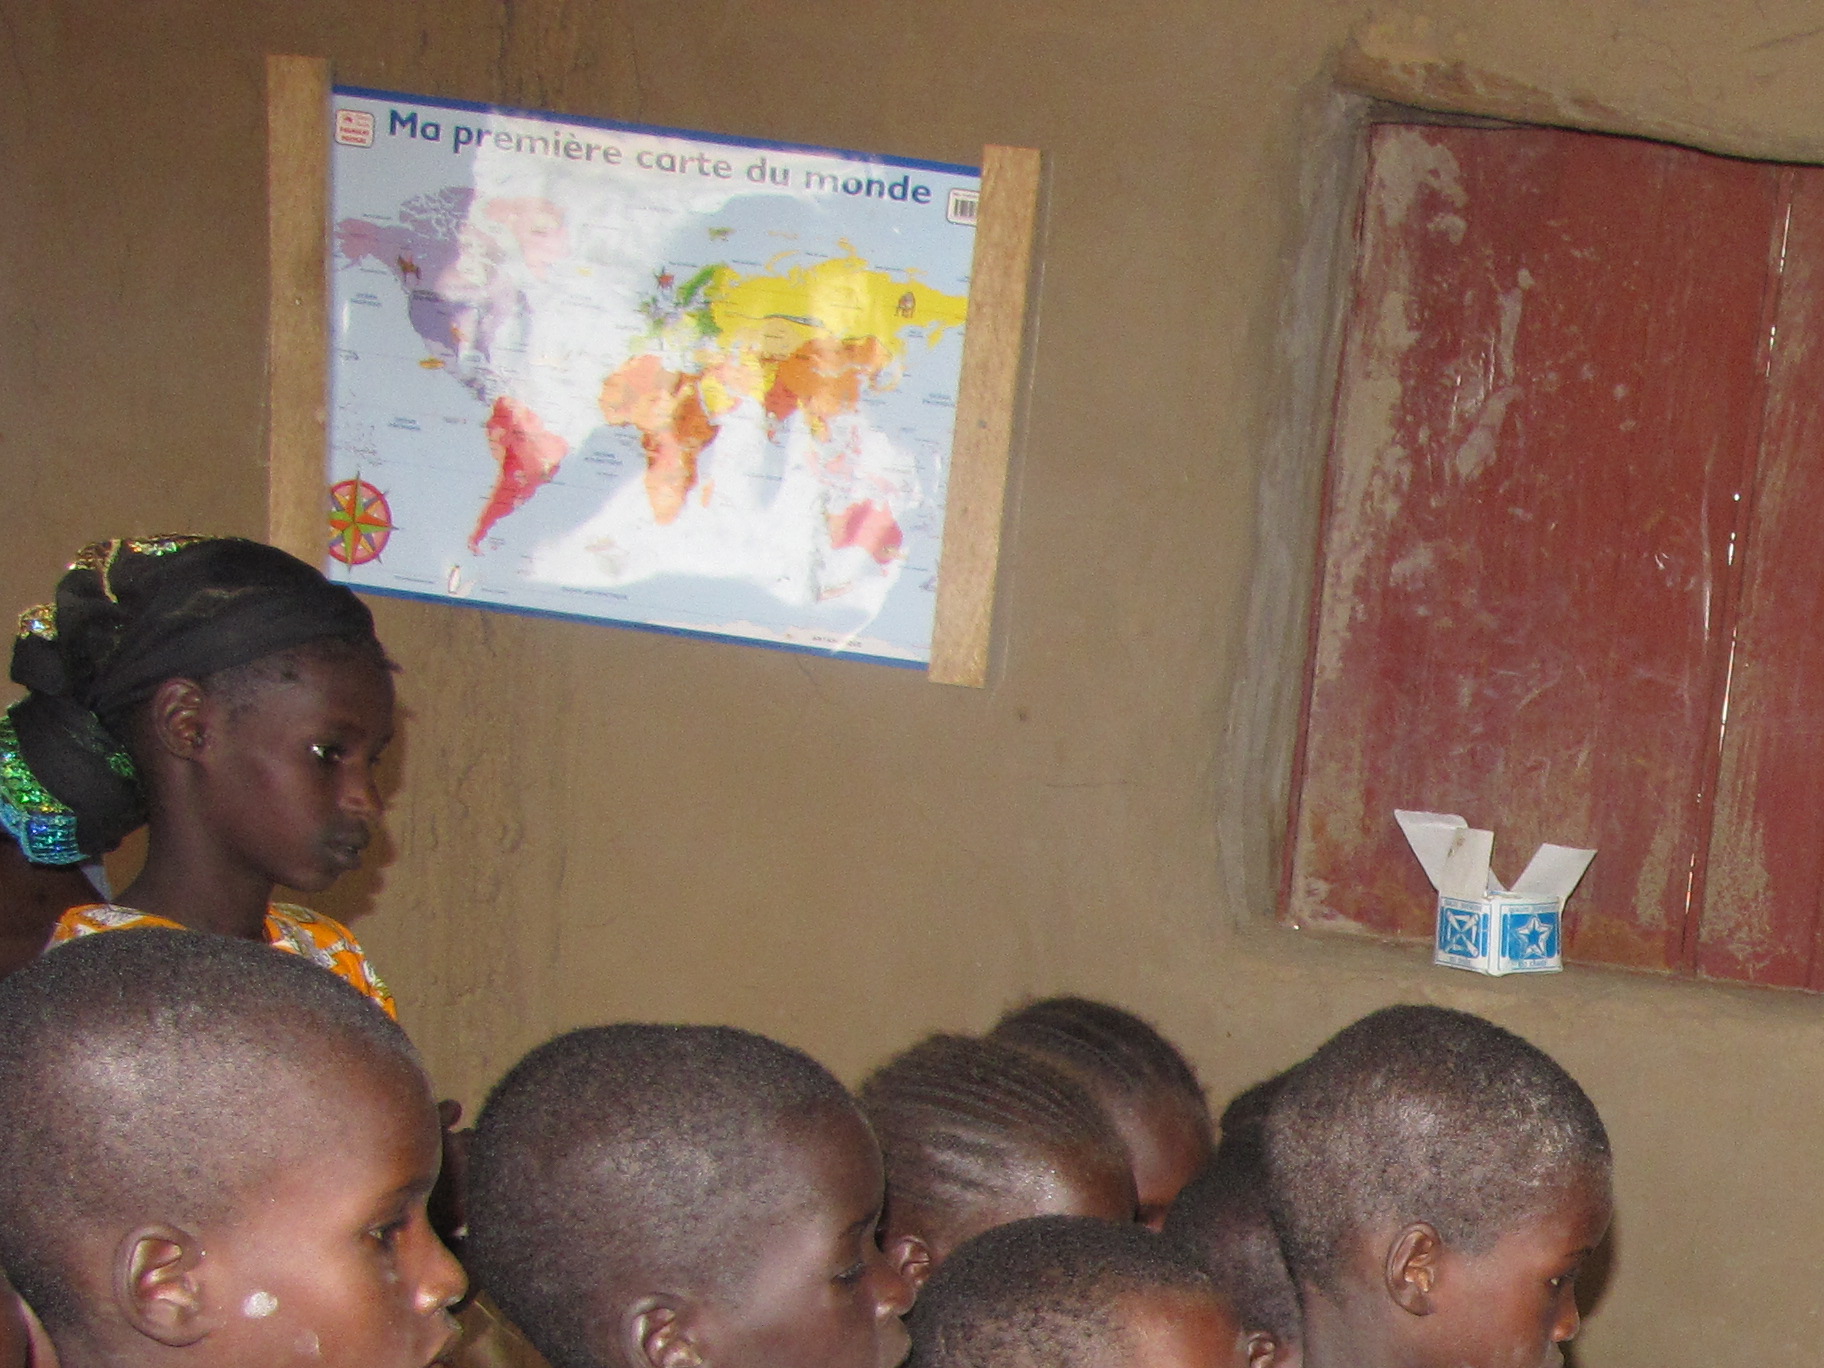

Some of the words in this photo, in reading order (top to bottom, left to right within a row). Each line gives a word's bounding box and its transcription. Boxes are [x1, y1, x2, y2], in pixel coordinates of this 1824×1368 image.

[388, 108, 442, 143] Ma
[452, 121, 624, 167] première
[636, 147, 734, 181] carte
[746, 156, 792, 188] du
[804, 170, 933, 206] monde
